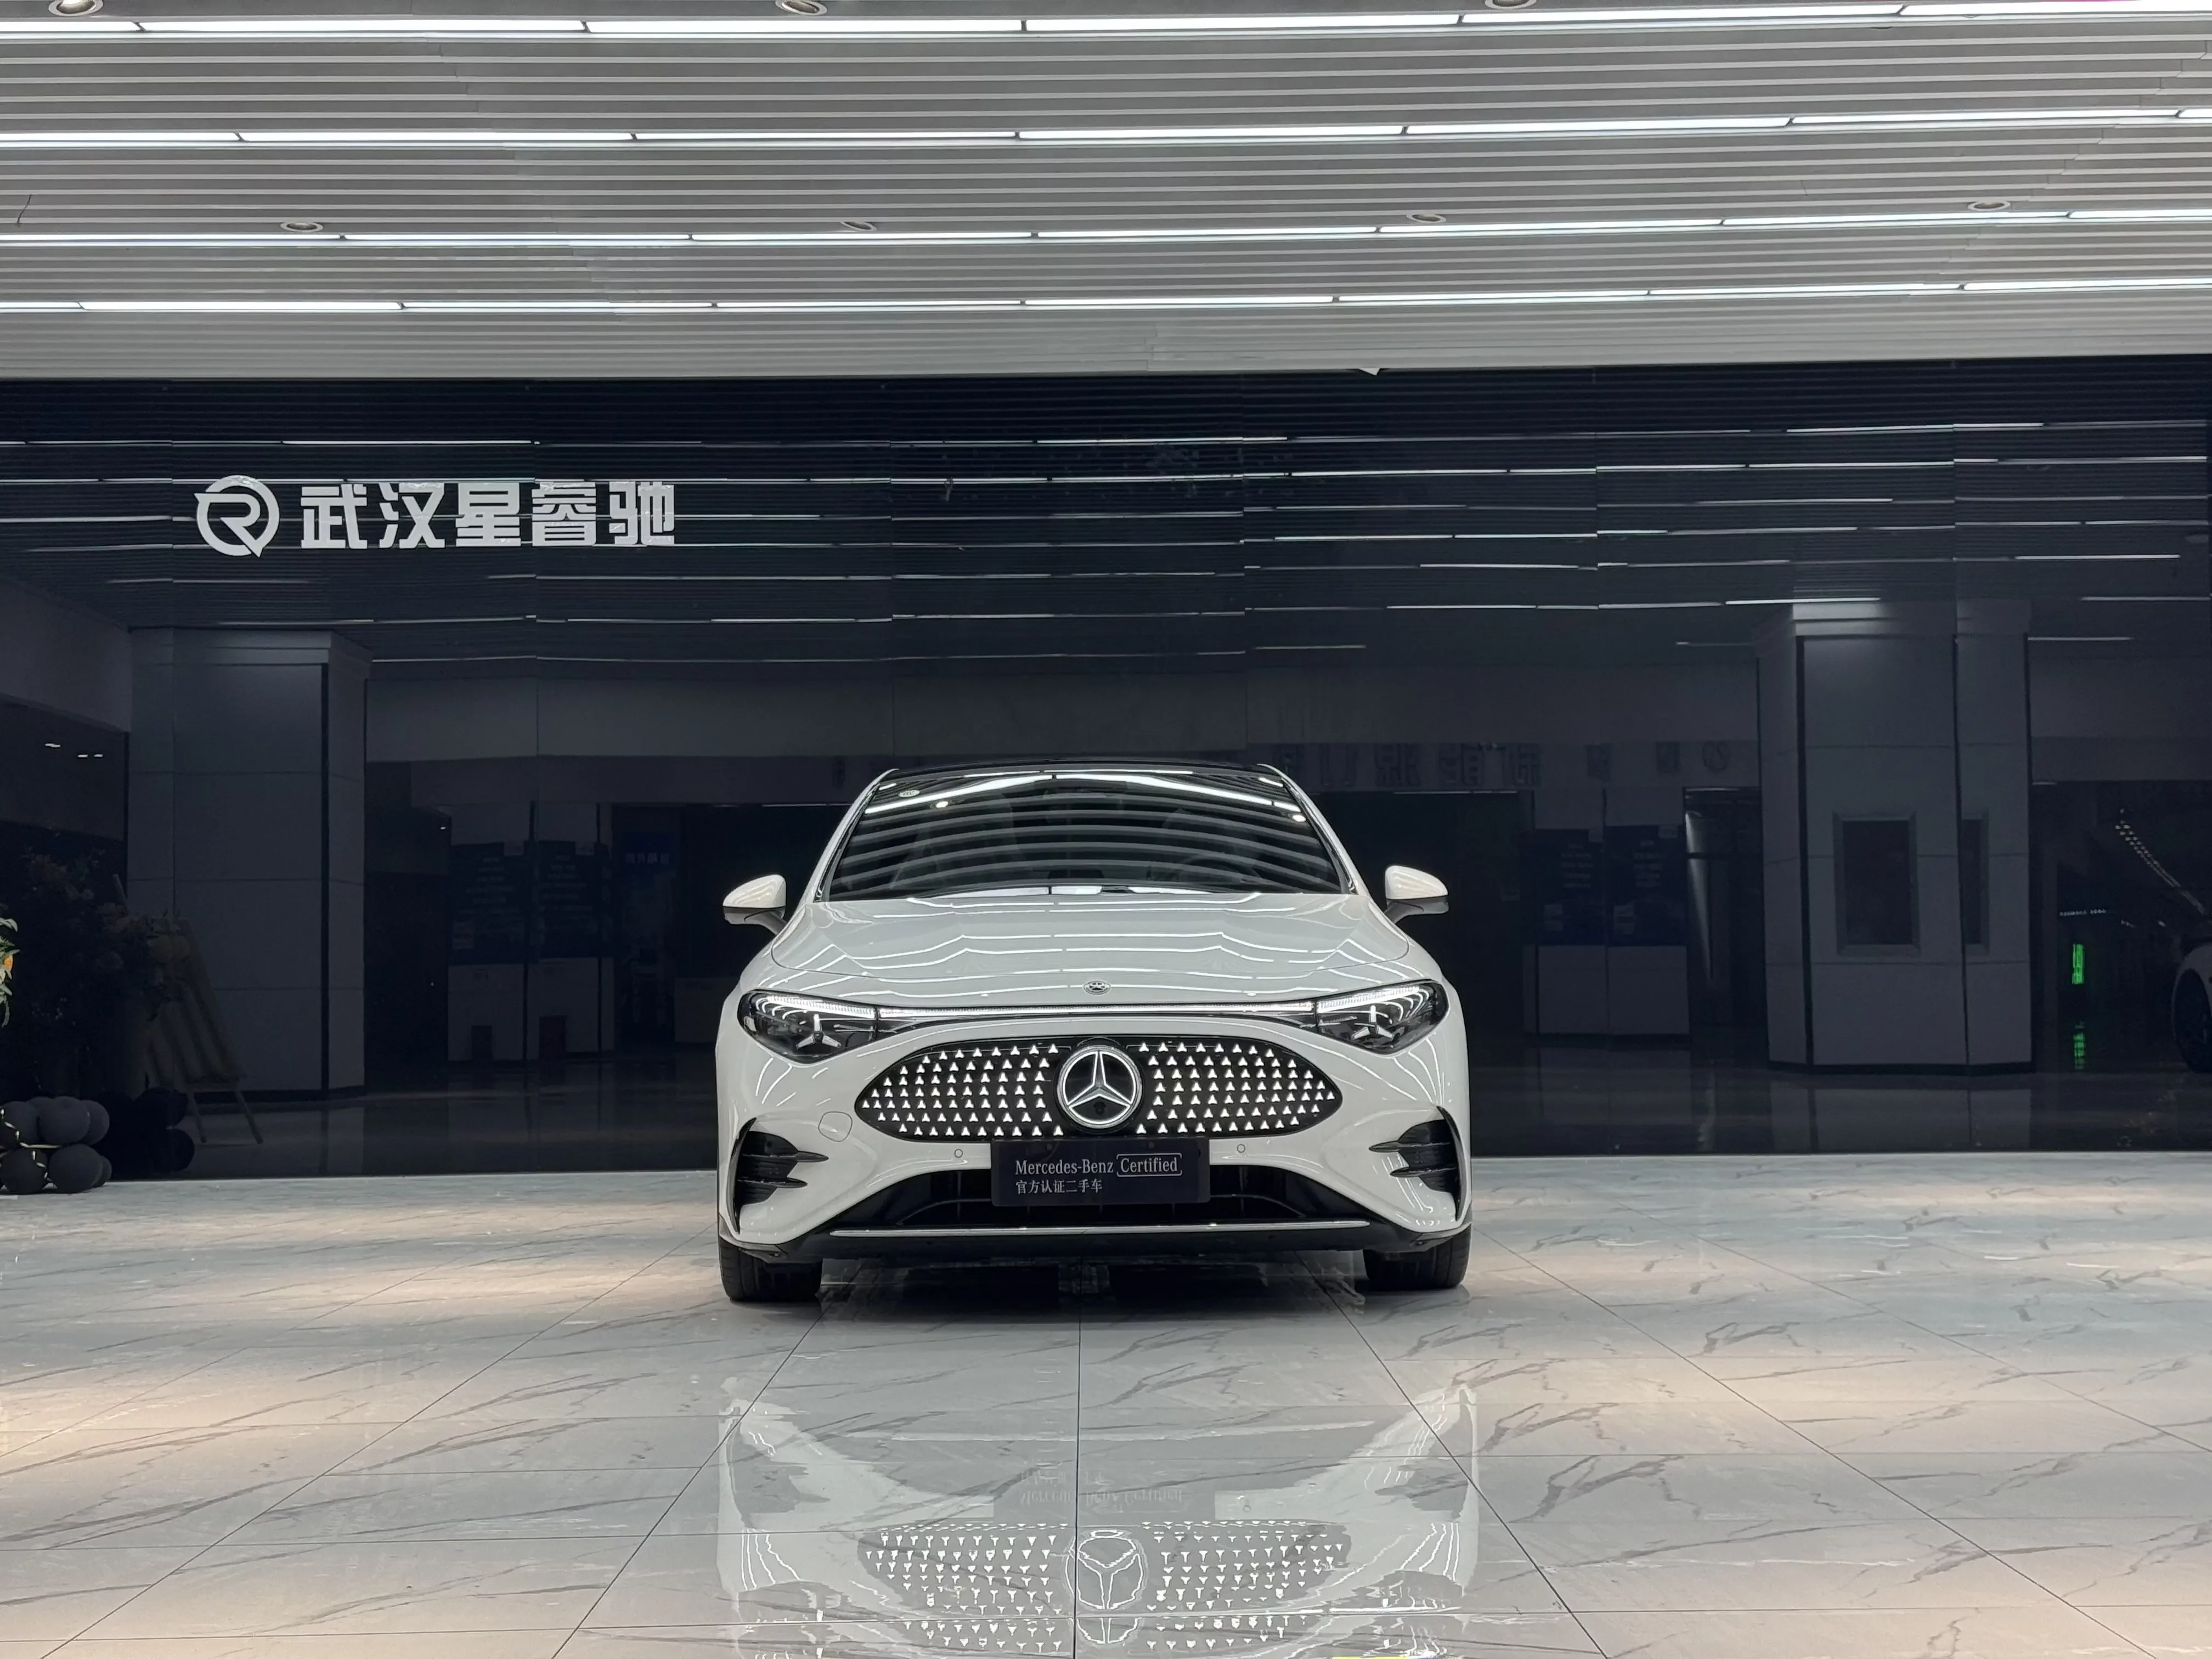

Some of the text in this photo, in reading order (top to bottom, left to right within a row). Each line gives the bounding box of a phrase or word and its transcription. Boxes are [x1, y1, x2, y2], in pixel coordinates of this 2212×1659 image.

[300, 481, 676, 549] 武汉星睿驰
[1015, 1156, 1178, 1175] Mercedes-Benz Certified
[1015, 1178, 1103, 1195] 官方认证二手车
